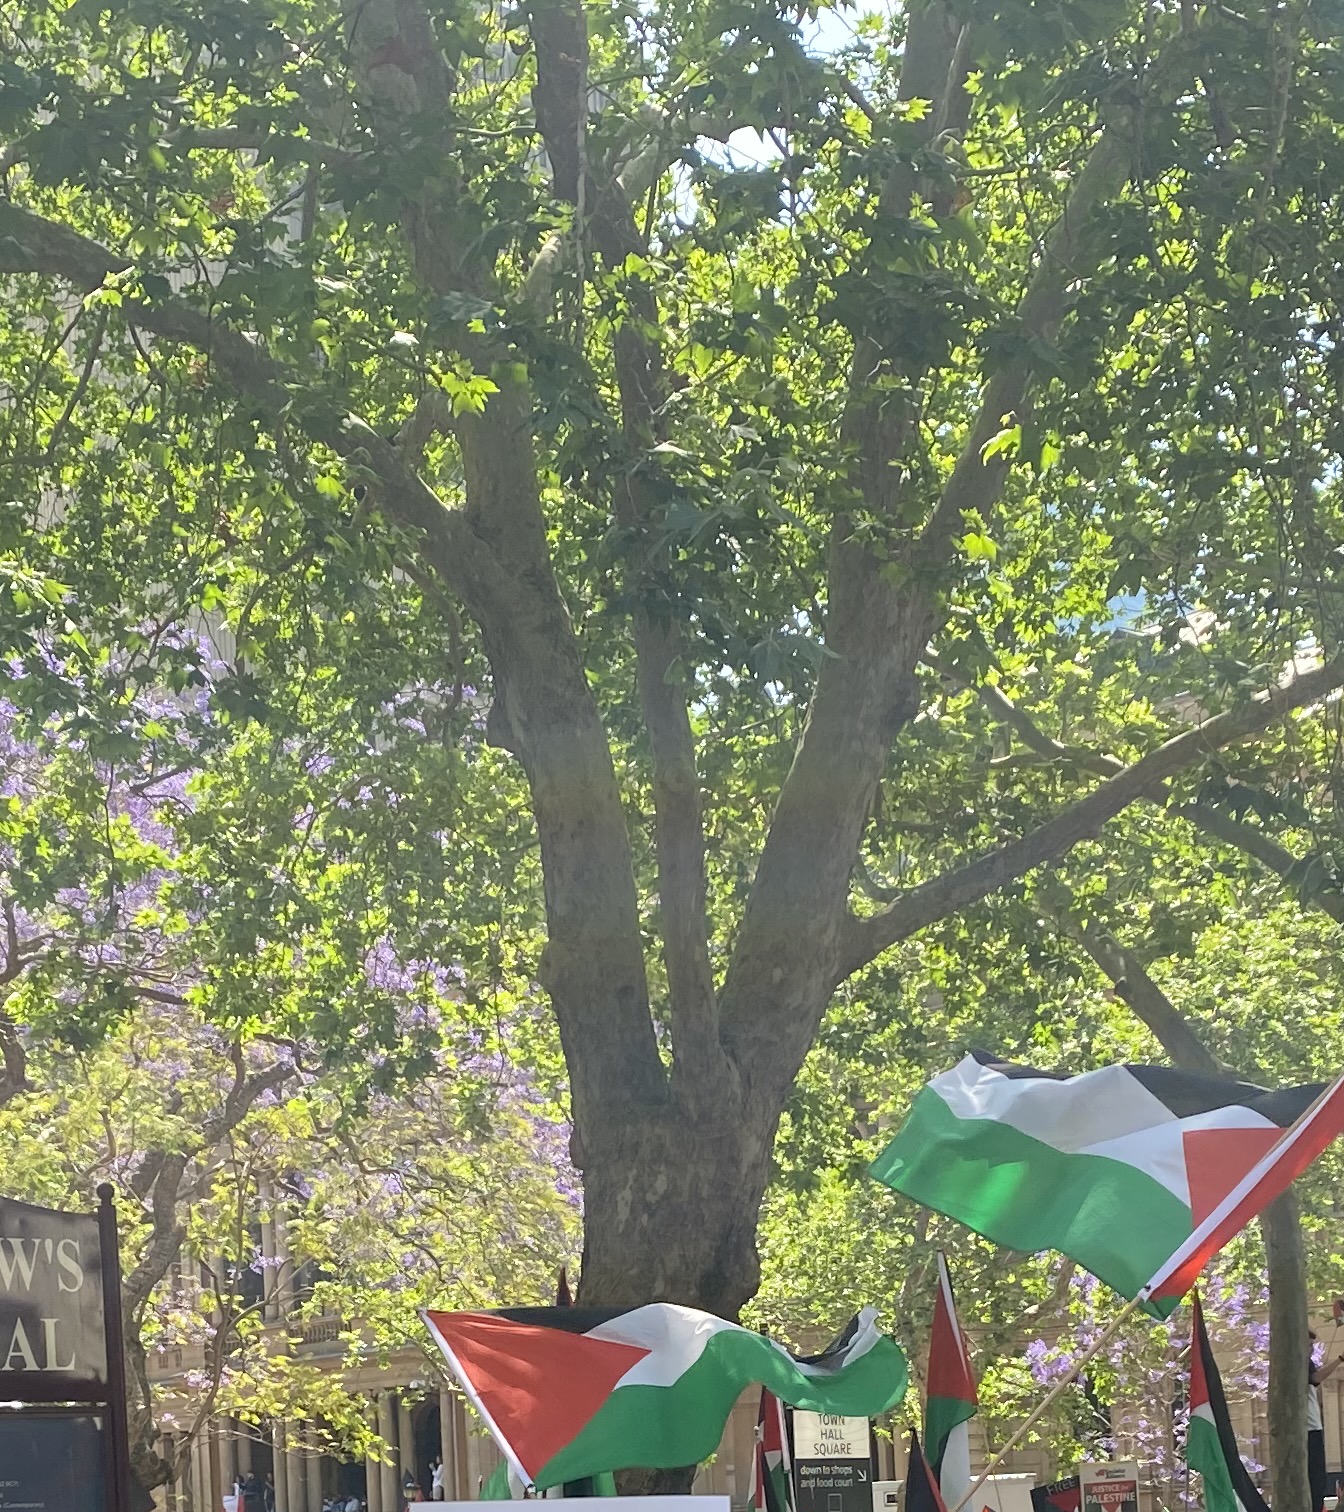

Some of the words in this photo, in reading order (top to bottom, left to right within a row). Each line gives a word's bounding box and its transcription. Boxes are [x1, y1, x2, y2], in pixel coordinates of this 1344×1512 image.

[818, 1413, 846, 1426] TOWN
[820, 1428, 845, 1440] HALL
[814, 1442, 852, 1456] SQUARE
[831, 1465, 853, 1476] shops
[1046, 1480, 1076, 1496] FREE
[1092, 1484, 1120, 1494] JUSTICE
[1086, 1491, 1136, 1505] PALESTINE
